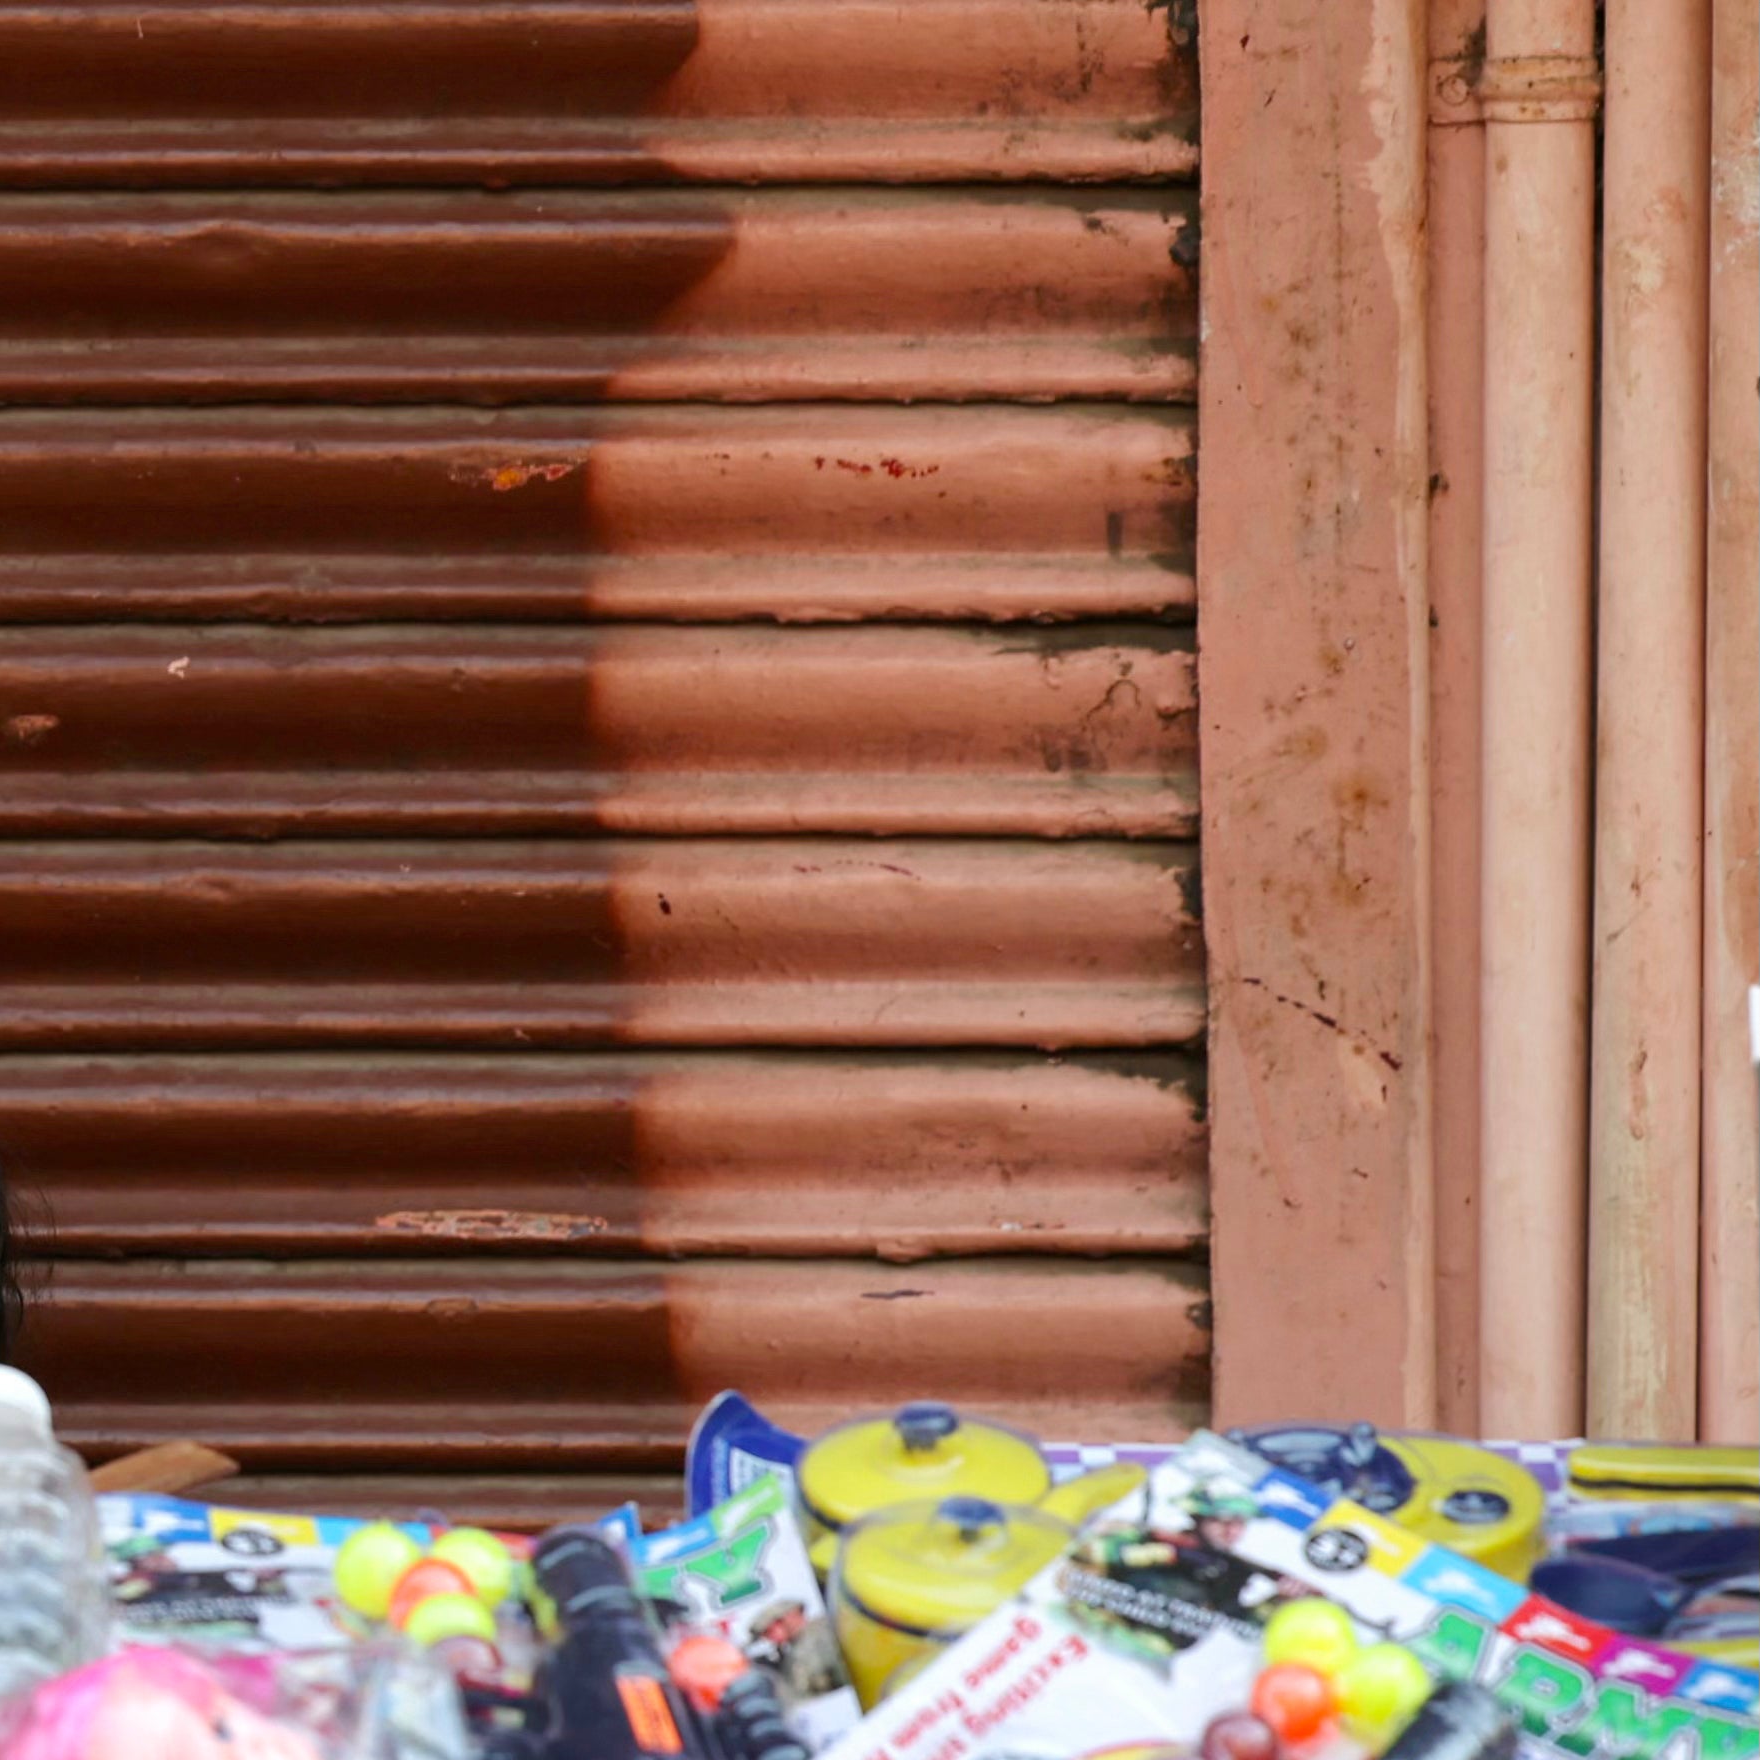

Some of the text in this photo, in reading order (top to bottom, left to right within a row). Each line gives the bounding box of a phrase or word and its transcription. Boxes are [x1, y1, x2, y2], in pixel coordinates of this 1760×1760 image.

[961, 1632, 1088, 1736] Exciting
[964, 1617, 1041, 1688] game
[892, 1690, 965, 1749] from
